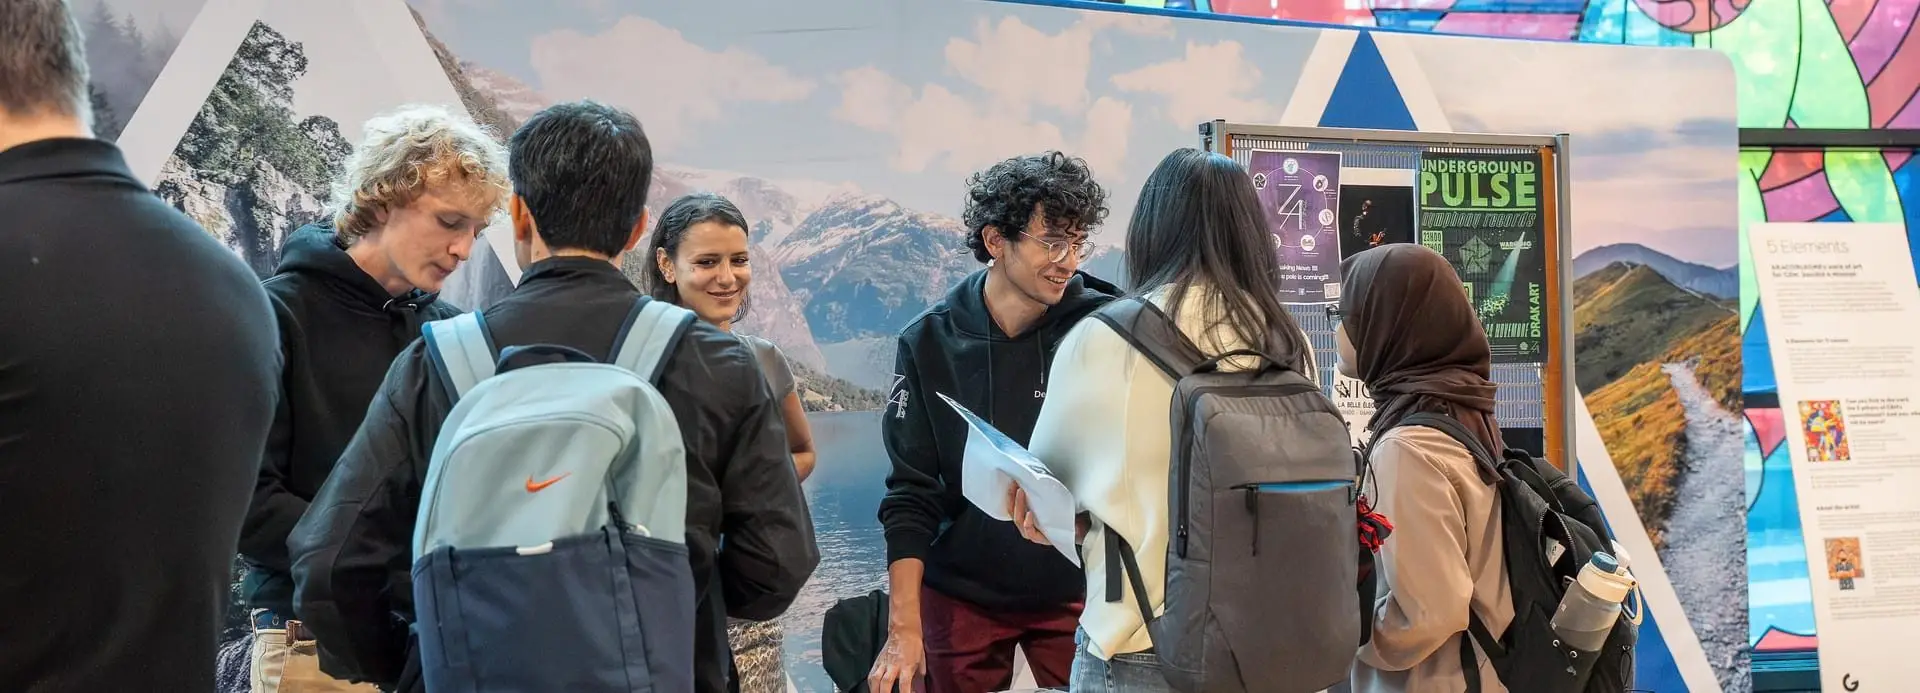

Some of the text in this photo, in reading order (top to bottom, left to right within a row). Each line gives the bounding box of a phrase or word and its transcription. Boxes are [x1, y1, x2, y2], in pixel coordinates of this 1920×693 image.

[1421, 159, 1535, 174] UNDERGROUND
[1421, 172, 1536, 207] PULSE
[1483, 211, 1537, 228] records
[1766, 239, 1849, 254] 5 Elements
[1280, 264, 1296, 272] aking
